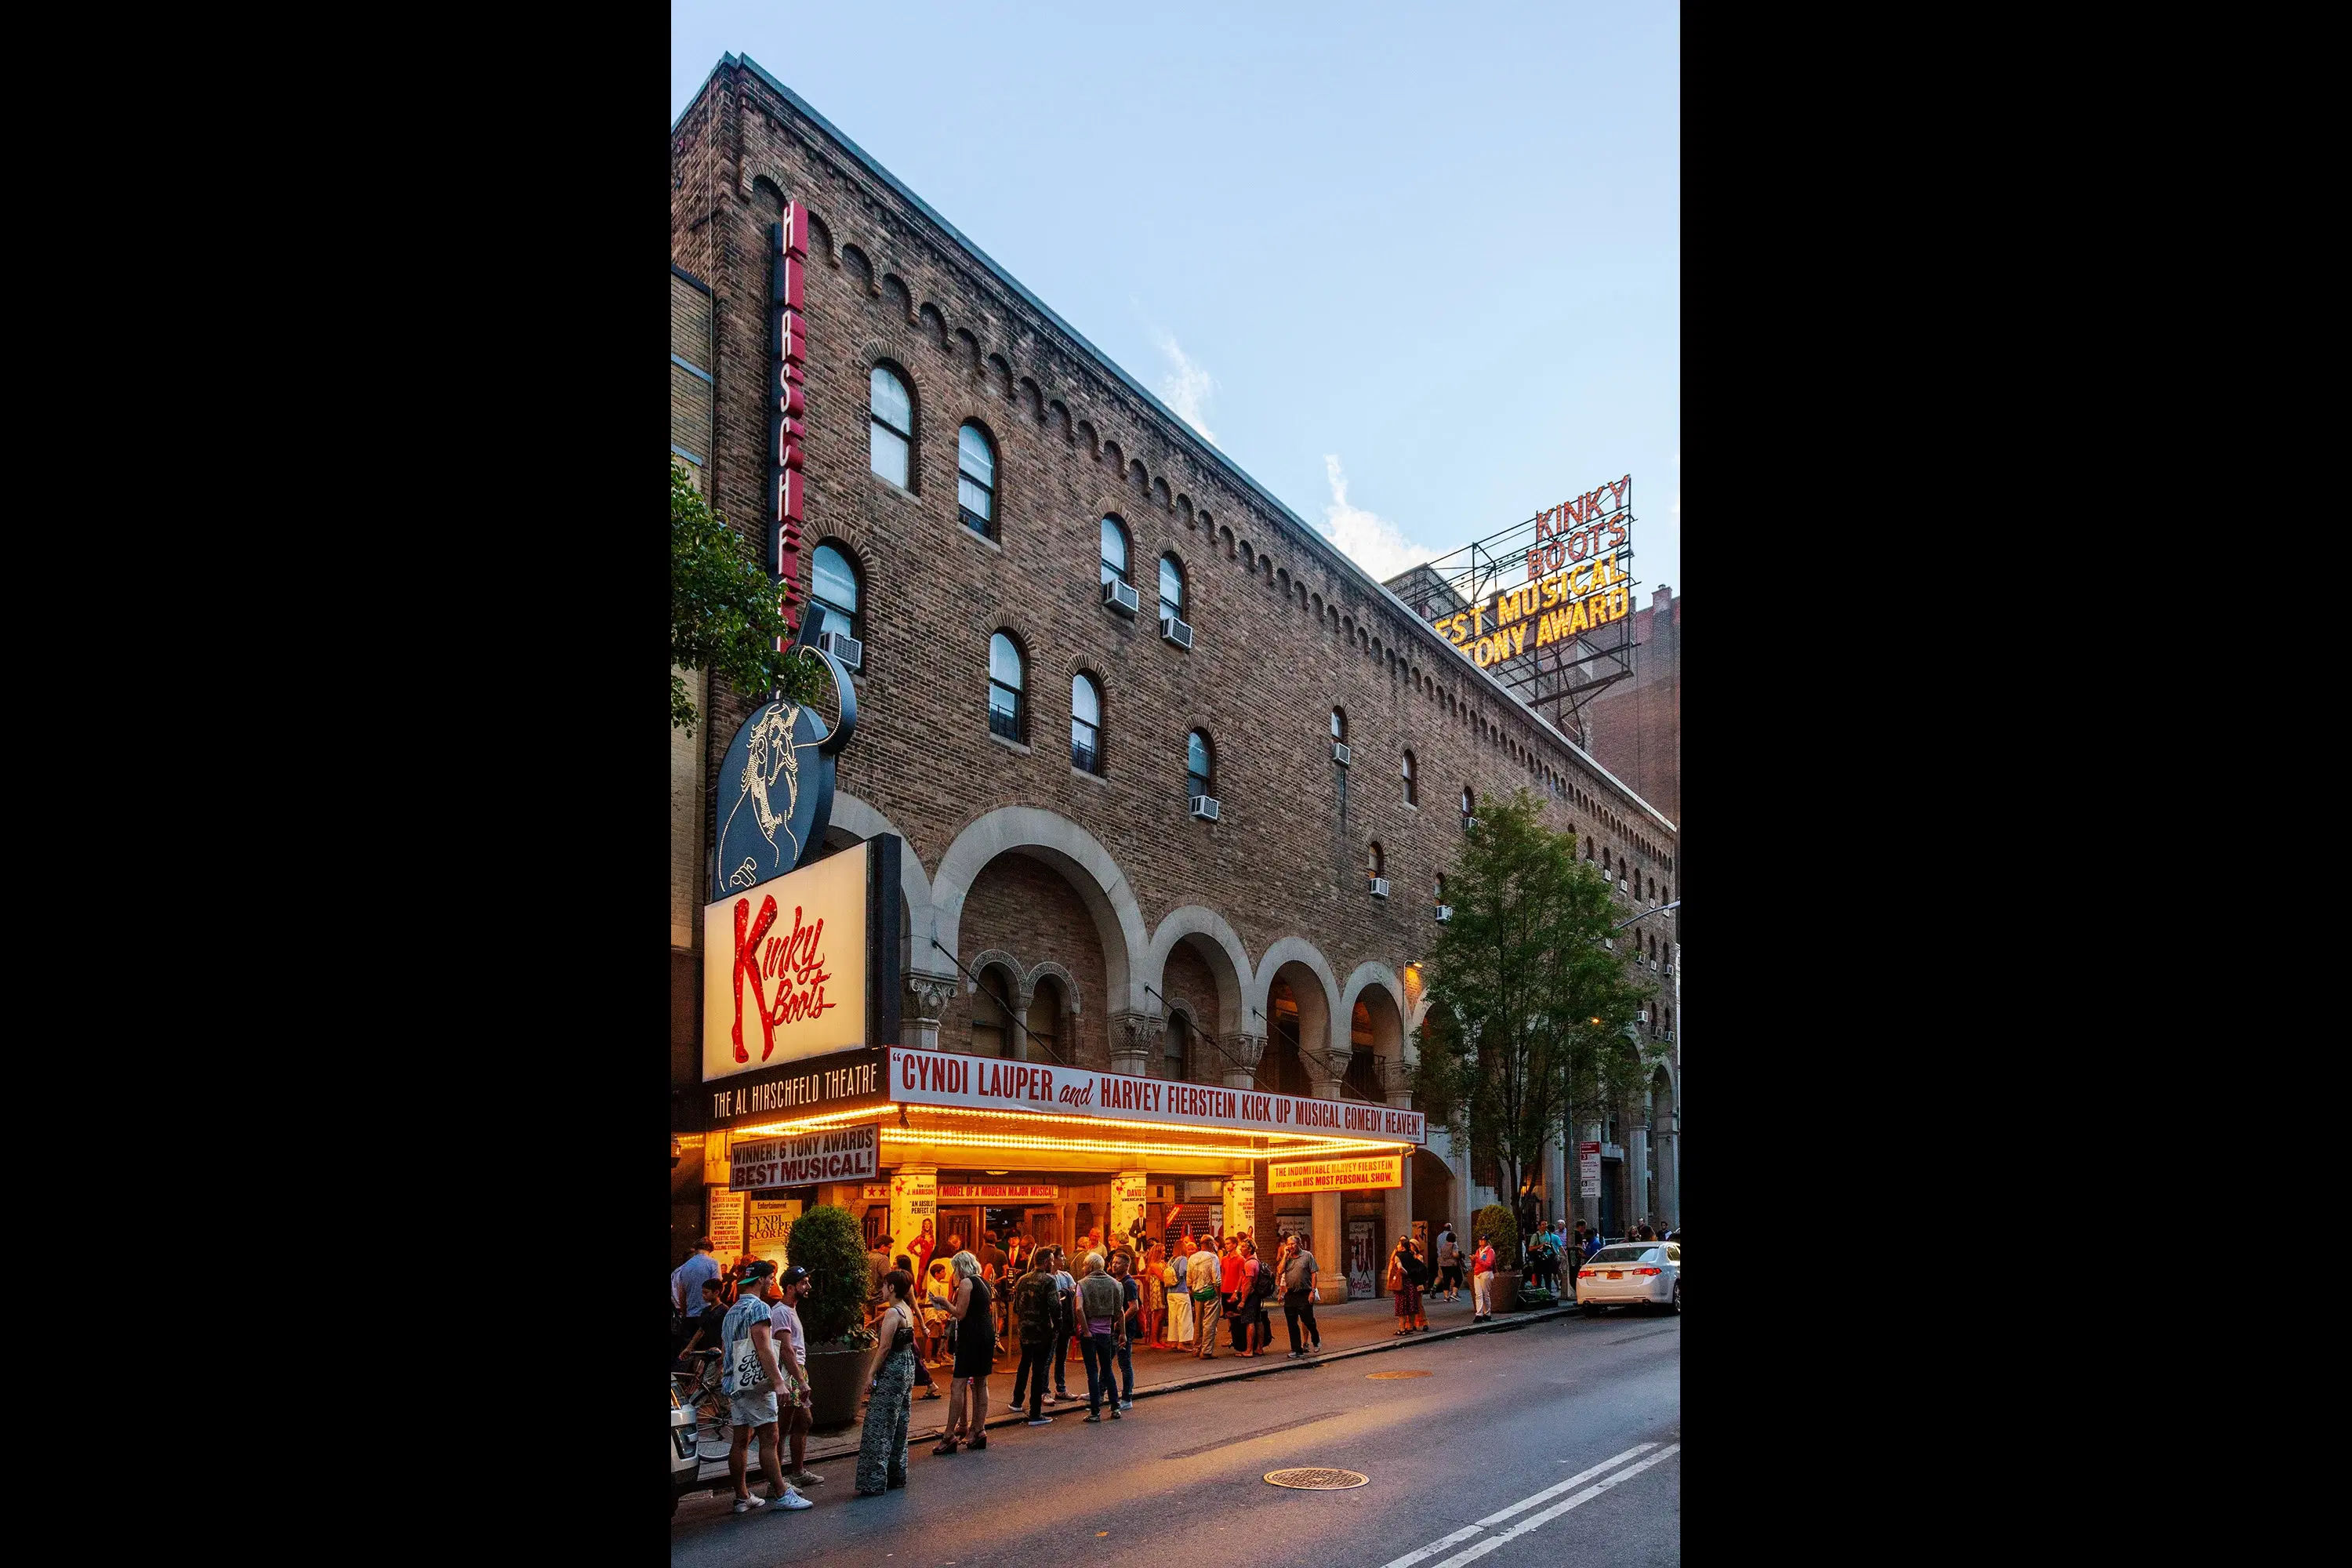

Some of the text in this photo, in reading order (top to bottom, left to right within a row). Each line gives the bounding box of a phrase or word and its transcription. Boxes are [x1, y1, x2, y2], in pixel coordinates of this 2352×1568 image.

[1537, 474, 1631, 543] KINKY
[1529, 514, 1627, 580] BOOTS
[1498, 554, 1628, 626] MUSICAL
[1536, 586, 1629, 648] AWARD
[731, 895, 825, 1064] Kinky
[772, 969, 837, 1026] Boots
[714, 1063, 877, 1119] THE AL HIRSCHFELD THEATRE
[978, 1062, 1053, 1102] LAUPER
[1058, 1078, 1094, 1108] and
[1101, 1077, 1161, 1112] HARVEY
[1167, 1086, 1236, 1119] FIERSTEIN
[1242, 1094, 1272, 1122] KICK
[1276, 1098, 1291, 1123] UP
[1295, 1101, 1341, 1129] MUSICAL
[1345, 1107, 1382, 1132] COMEDY
[733, 1128, 873, 1165] WINNER! 6 TONY AWARDS
[735, 1163, 779, 1187] BEST
[781, 1151, 873, 1183] MUSICAL!
[1288, 1164, 1330, 1176] INDOMITABLE
[1332, 1163, 1356, 1174] HARVEY
[1358, 1160, 1393, 1171] FIERSTEIN
[942, 1185, 964, 1196] MODEL
[966, 1185, 974, 1196] OF
[975, 1185, 979, 1196] A
[981, 1185, 1006, 1196] MODERN
[1008, 1185, 1029, 1196] MAJOR
[1276, 1180, 1292, 1189] returns
[1293, 1178, 1302, 1187] with
[1303, 1178, 1314, 1186] HIS
[1316, 1176, 1334, 1186] MOST
[1335, 1174, 1370, 1185] PERSONAL
[750, 1214, 782, 1225] CYNDI
[750, 1229, 789, 1240] SCORES
